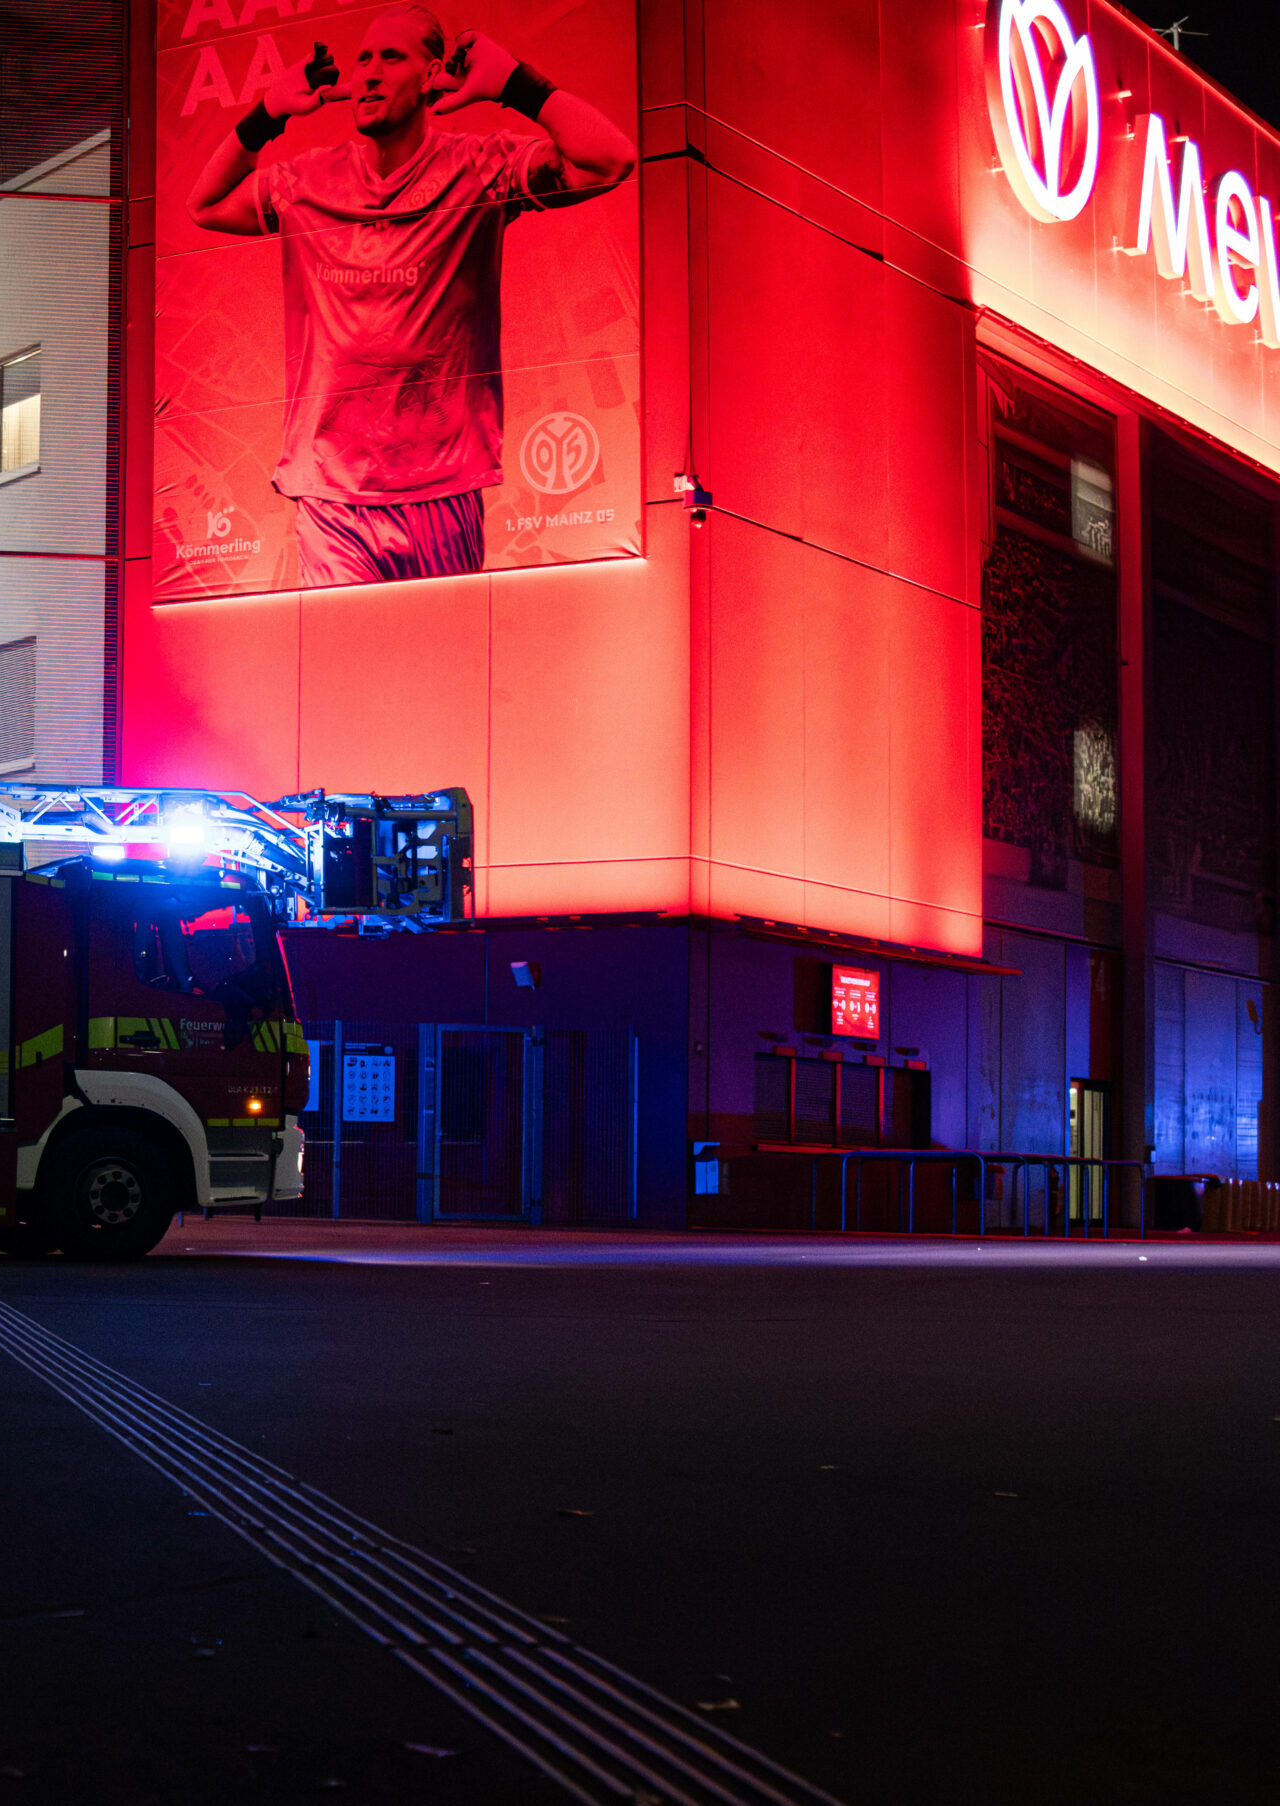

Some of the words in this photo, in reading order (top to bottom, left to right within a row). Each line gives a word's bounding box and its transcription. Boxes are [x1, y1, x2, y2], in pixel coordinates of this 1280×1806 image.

[505, 519, 515, 531] 1.
[518, 515, 542, 530] FSV
[545, 511, 593, 527] MAINZ
[596, 509, 615, 522] 05
[176, 537, 261, 559] Kömmerling
